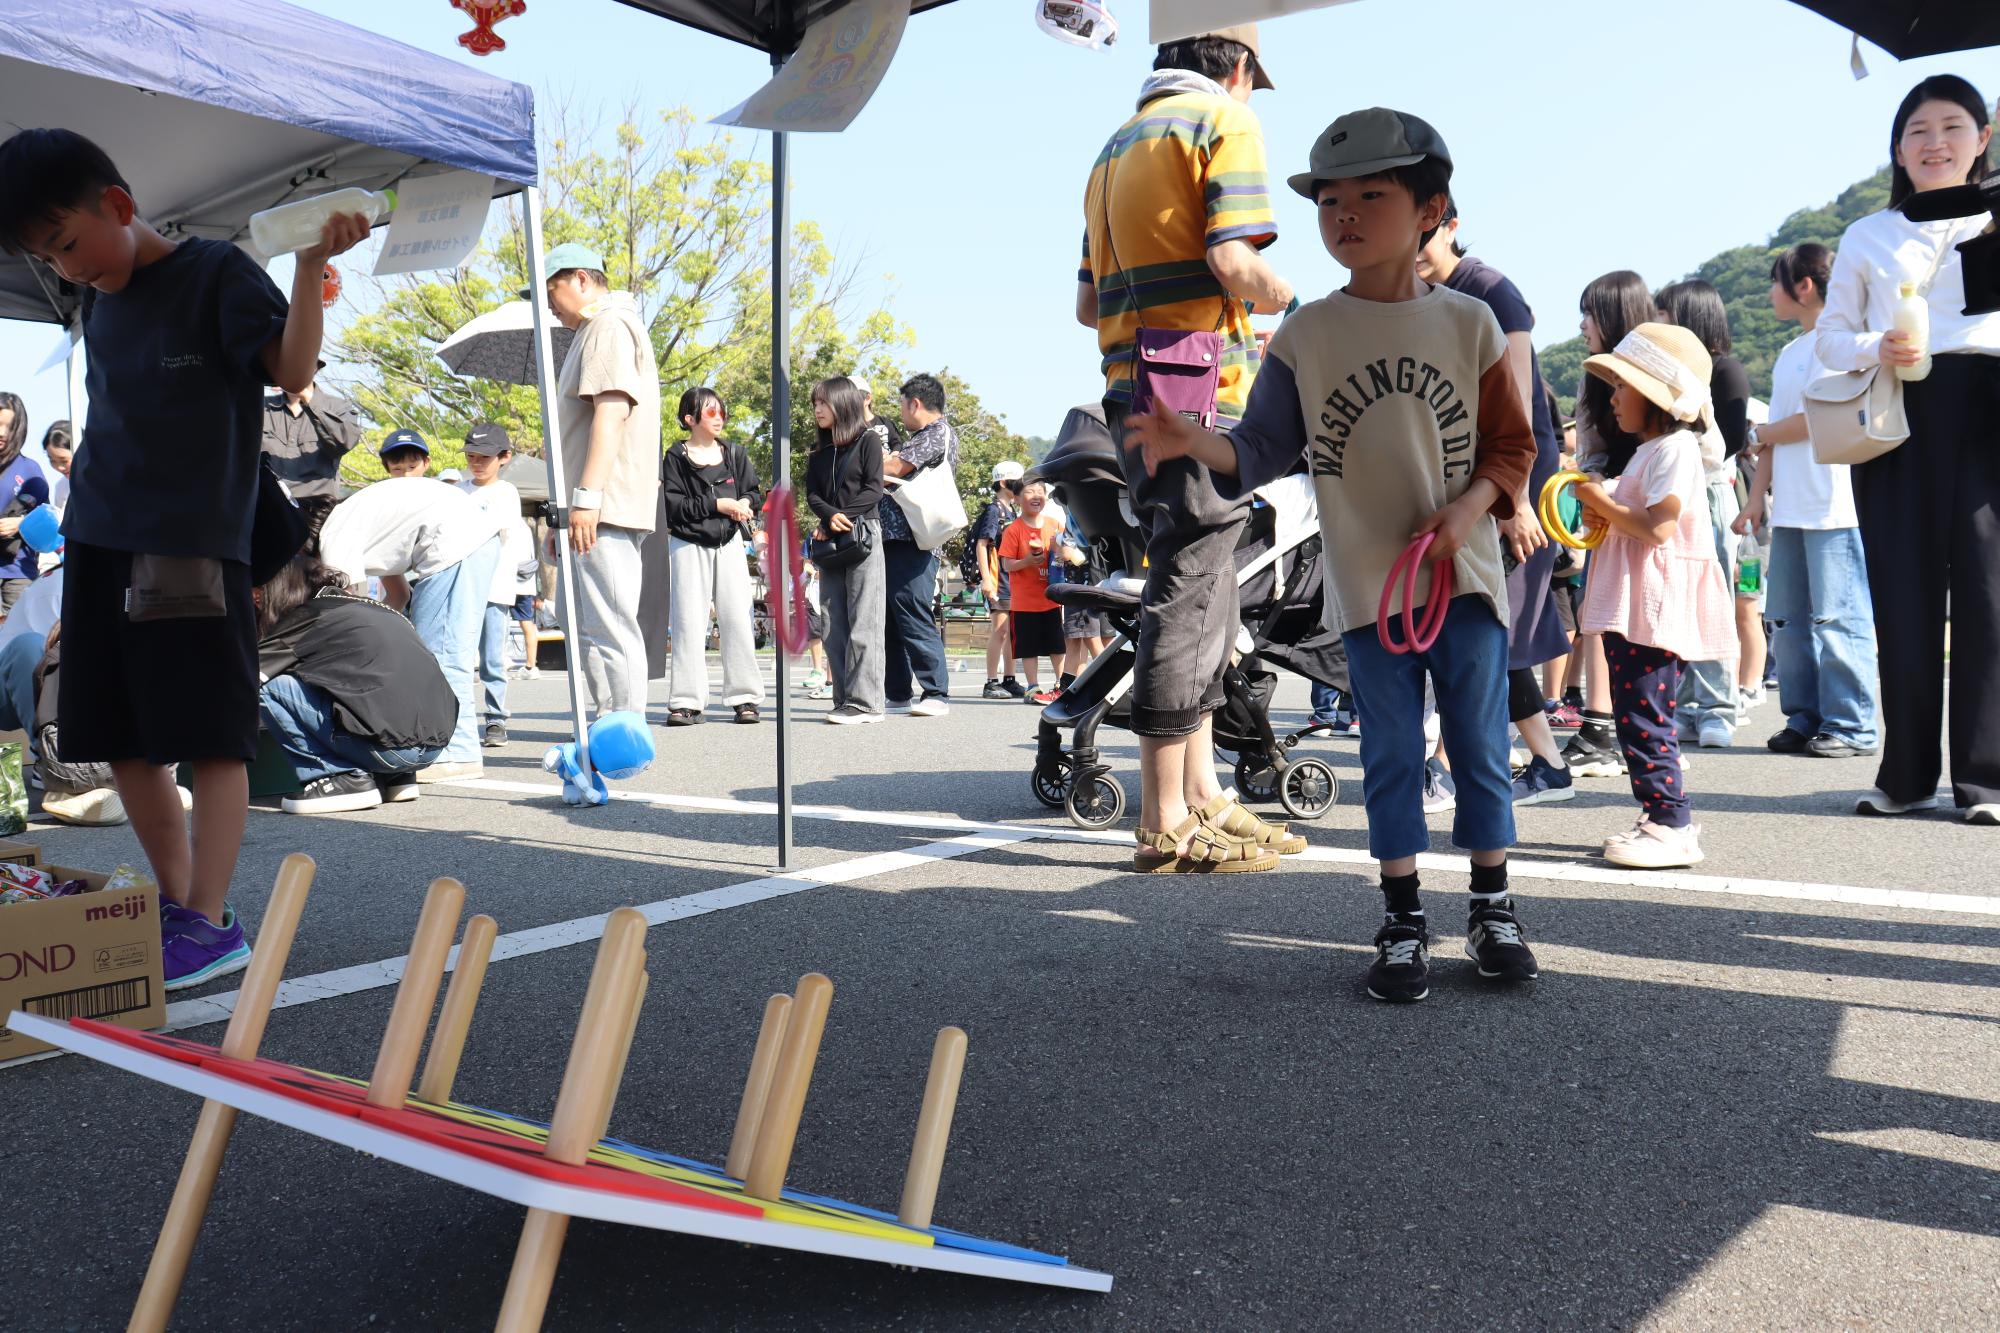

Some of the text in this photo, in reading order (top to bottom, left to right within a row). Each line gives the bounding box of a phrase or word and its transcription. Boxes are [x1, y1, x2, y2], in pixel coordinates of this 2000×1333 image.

[1313, 357, 1471, 484] WASHINGTON D.C.
[85, 895, 146, 922] meiji
[0, 943, 76, 982] OND
